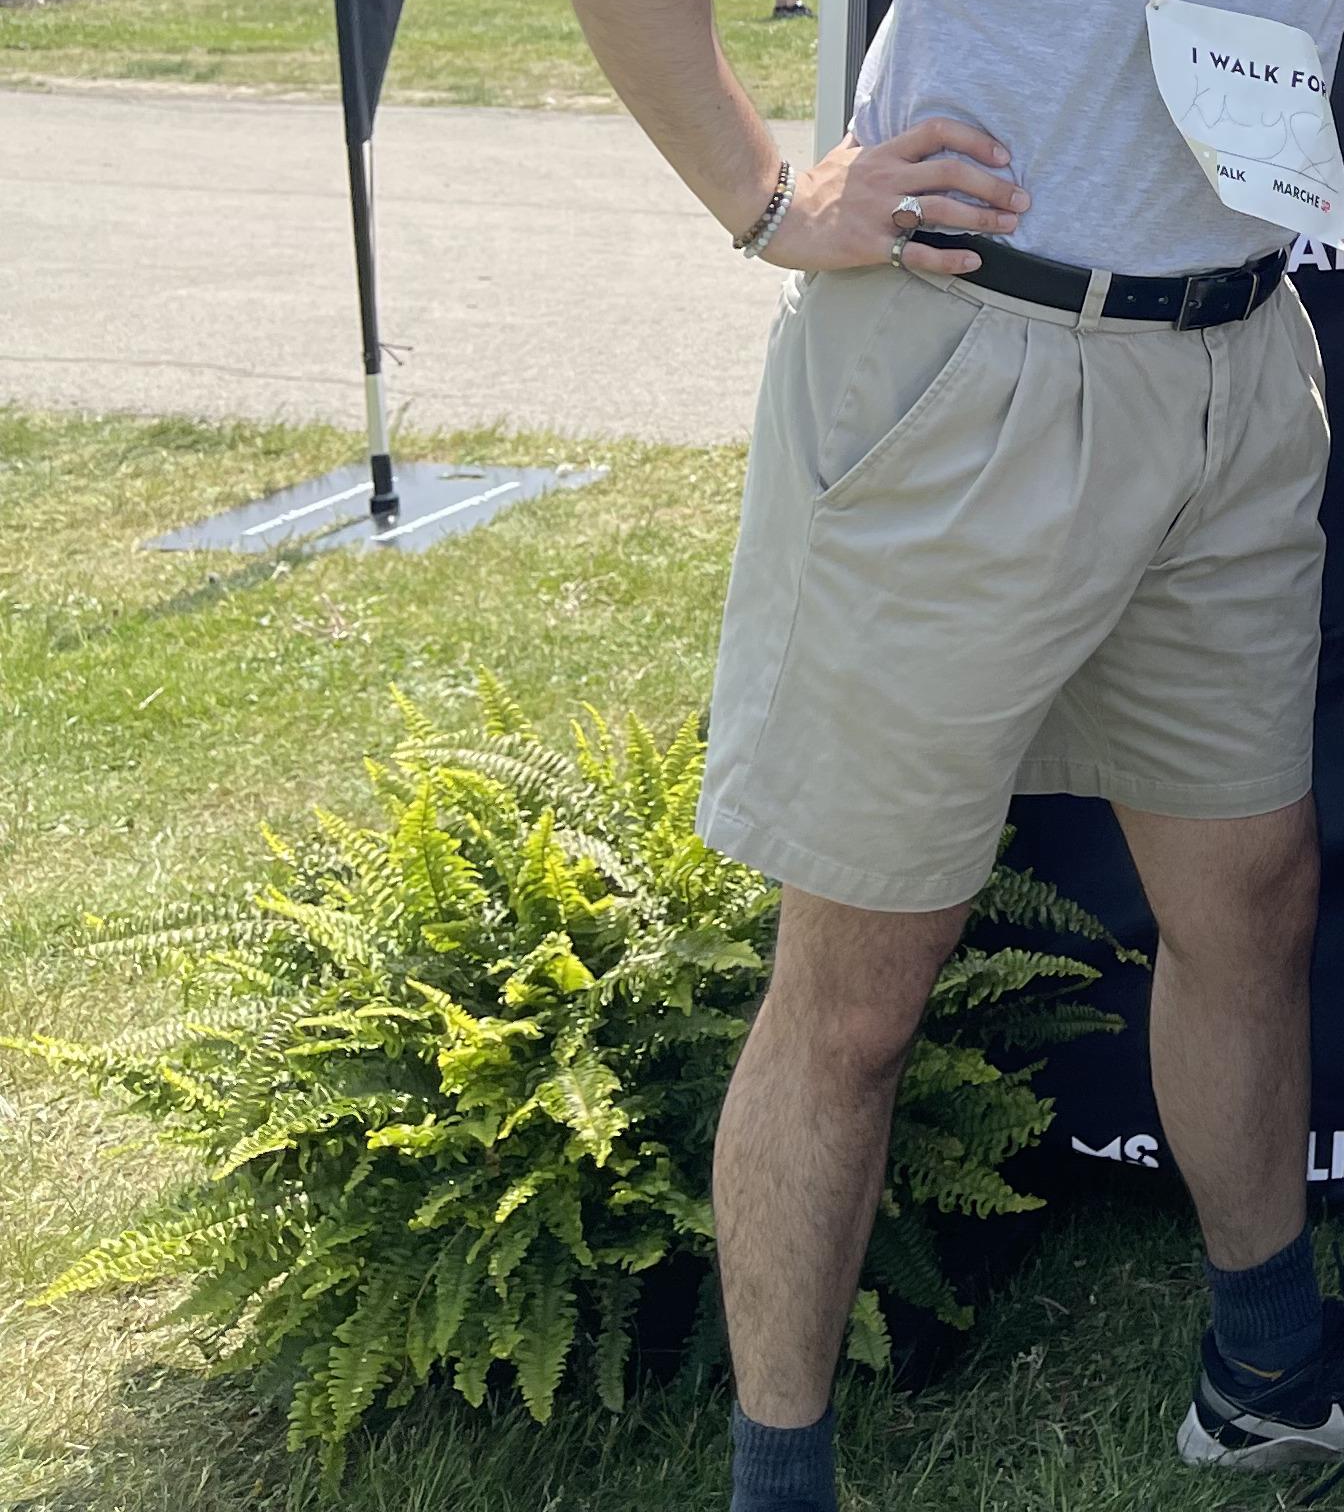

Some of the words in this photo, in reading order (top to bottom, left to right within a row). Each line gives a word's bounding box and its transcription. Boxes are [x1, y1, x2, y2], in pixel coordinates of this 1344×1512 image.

[1192, 47, 1198, 64] I
[1209, 51, 1280, 84] WALK
[1273, 179, 1320, 208] MARCHE
